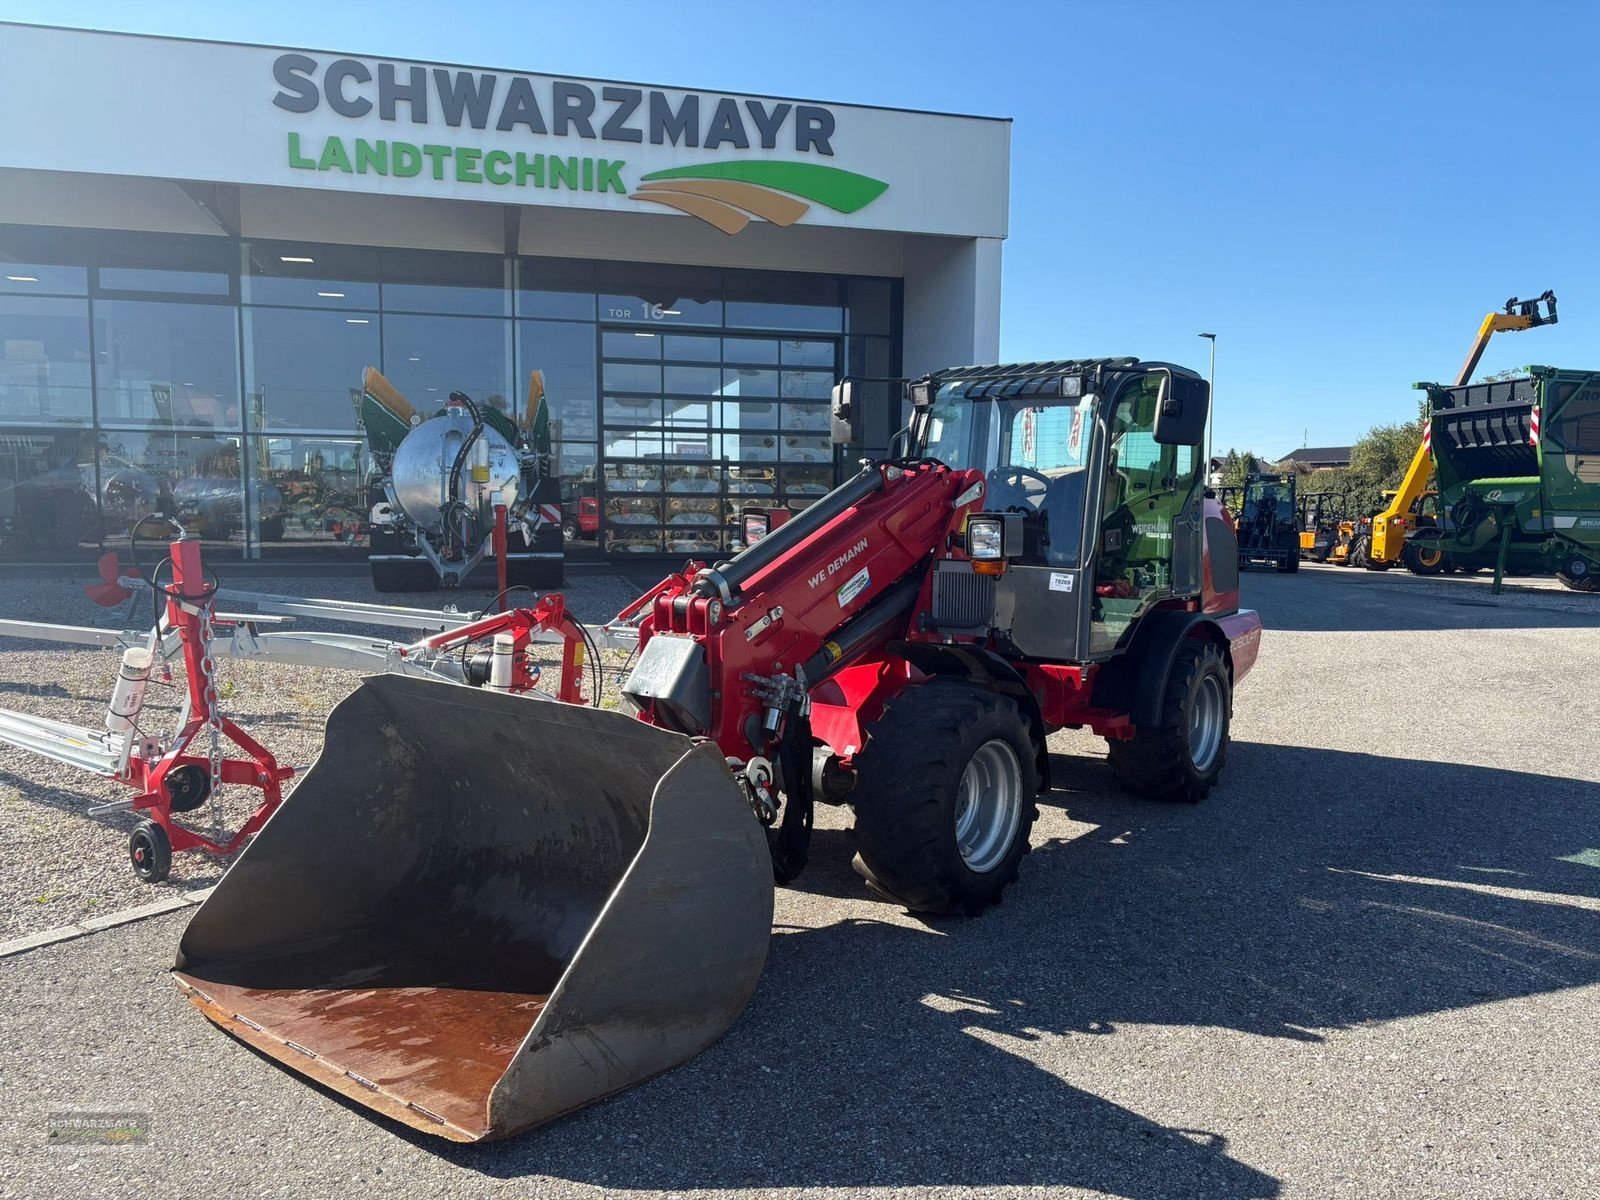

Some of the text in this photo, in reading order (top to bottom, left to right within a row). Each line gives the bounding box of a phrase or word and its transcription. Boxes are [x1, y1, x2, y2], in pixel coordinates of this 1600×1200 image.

[272, 53, 836, 156] SCHWARZMAYR
[288, 132, 627, 194] LANDTECHNIK
[608, 302, 665, 320] TOR 16
